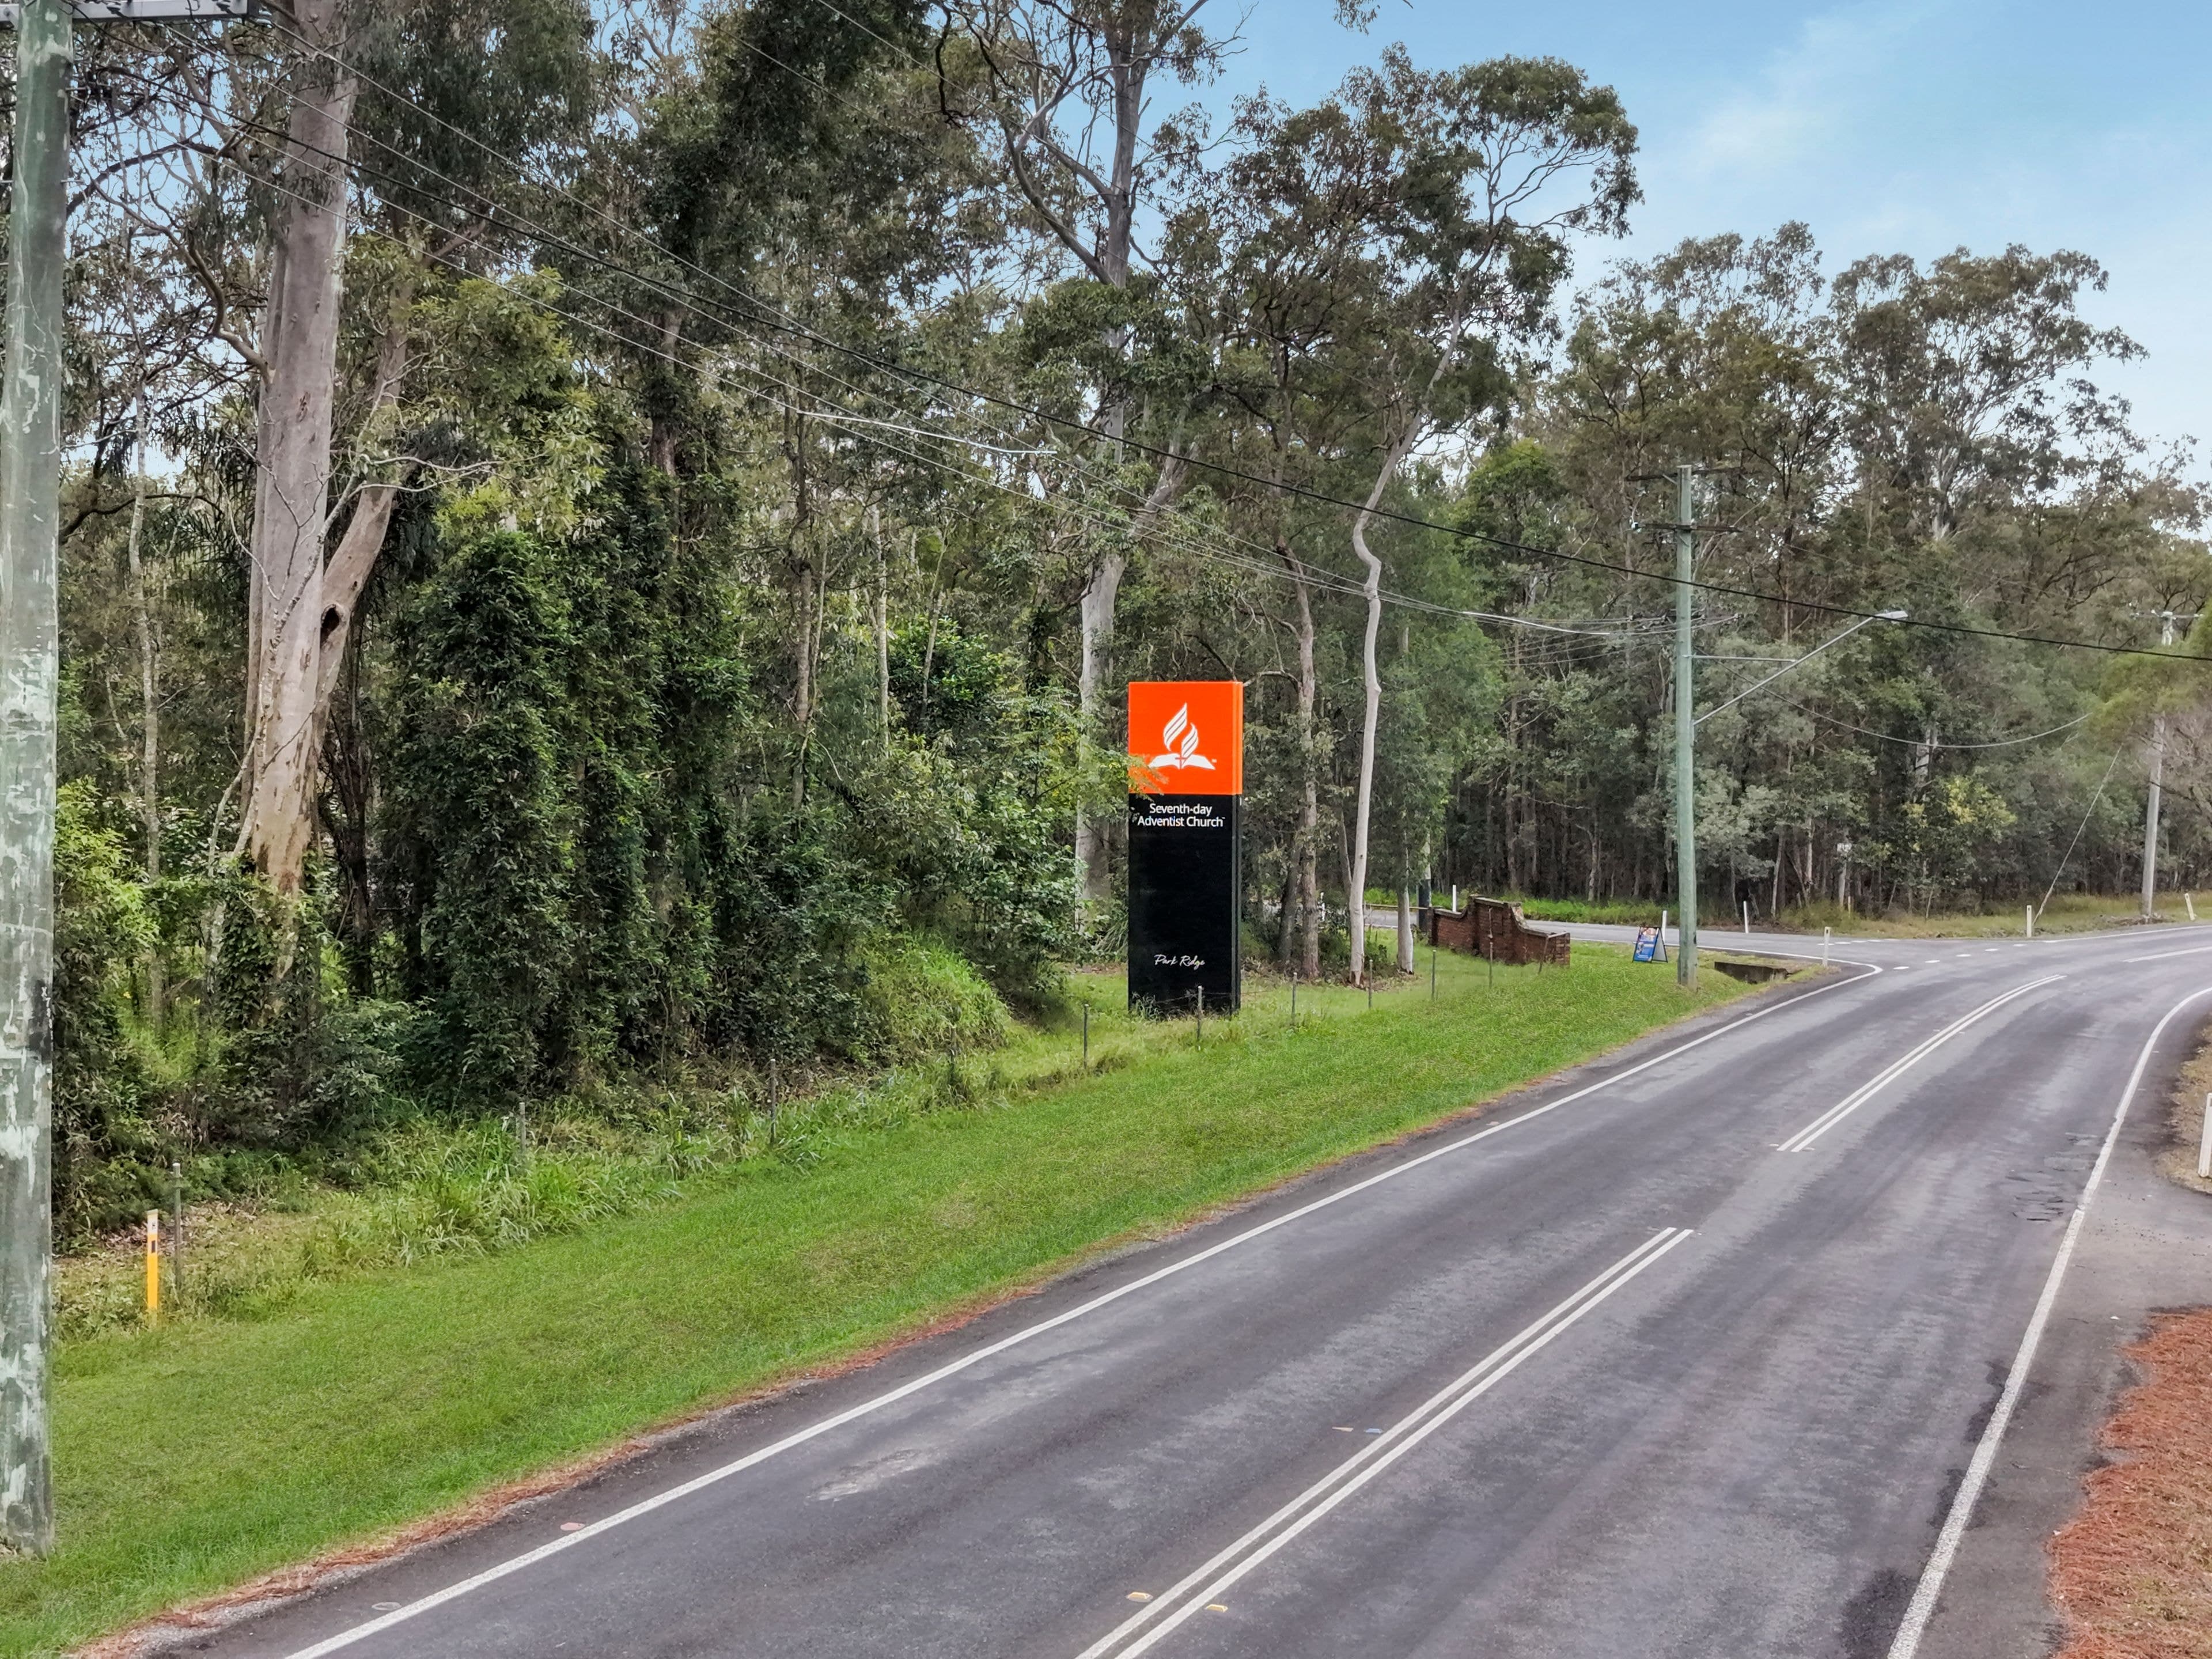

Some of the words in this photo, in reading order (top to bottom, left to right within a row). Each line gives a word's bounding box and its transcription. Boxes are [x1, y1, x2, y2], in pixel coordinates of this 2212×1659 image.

[1149, 803, 1213, 817] Seventh-day
[1137, 816, 1184, 827] Adventist
[1187, 816, 1224, 827] Church
[1154, 954, 1177, 965] Park
[1179, 955, 1205, 970] Ridge
